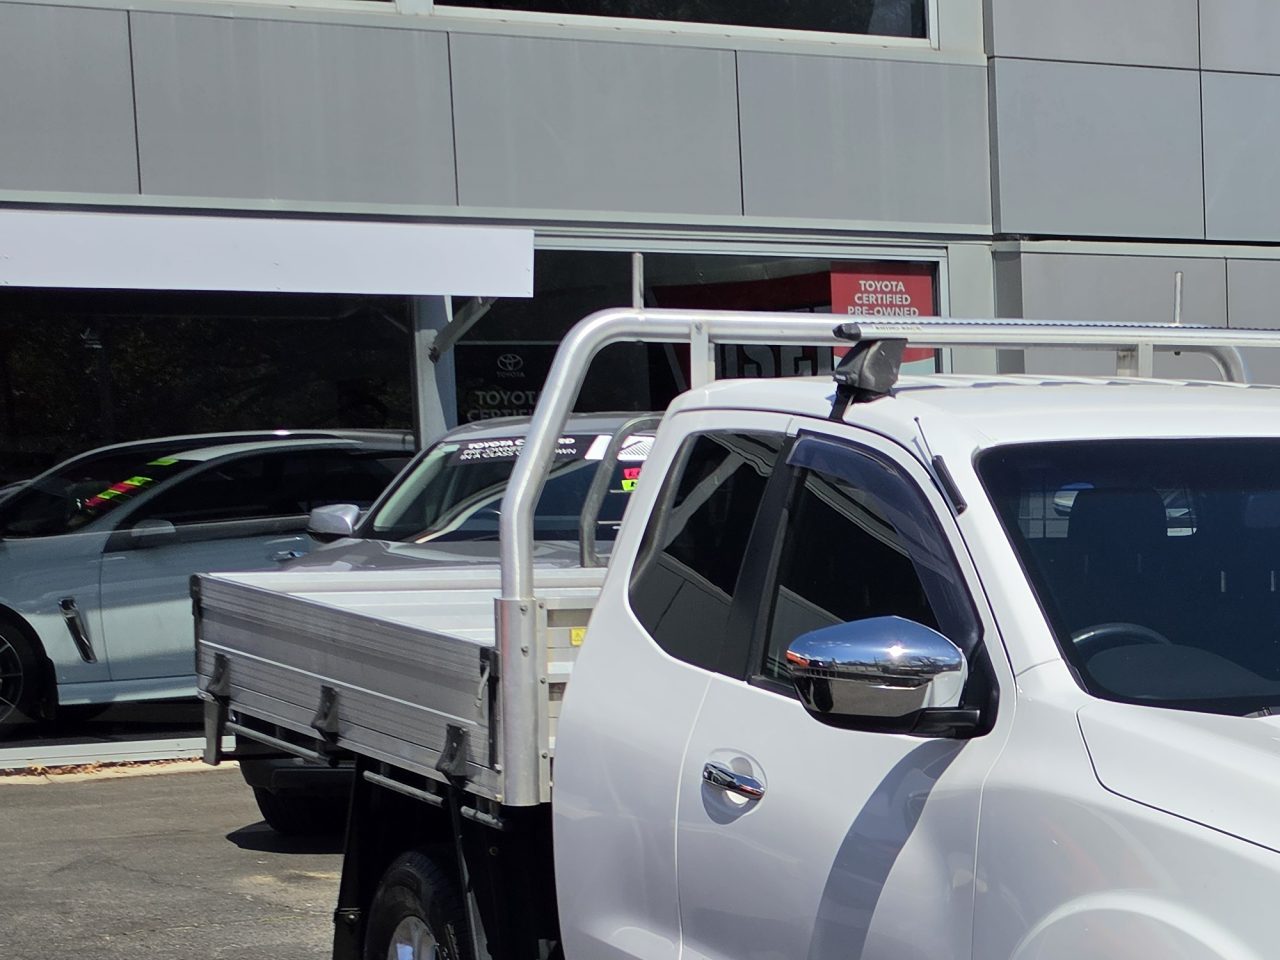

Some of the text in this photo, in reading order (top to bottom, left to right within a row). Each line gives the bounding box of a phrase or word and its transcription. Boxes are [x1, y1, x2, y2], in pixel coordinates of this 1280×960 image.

[858, 280, 906, 292] TOYOTA
[854, 293, 911, 305] CERTIFIED
[847, 306, 919, 317] PRE-OWNED
[475, 391, 540, 406] TOYOT
